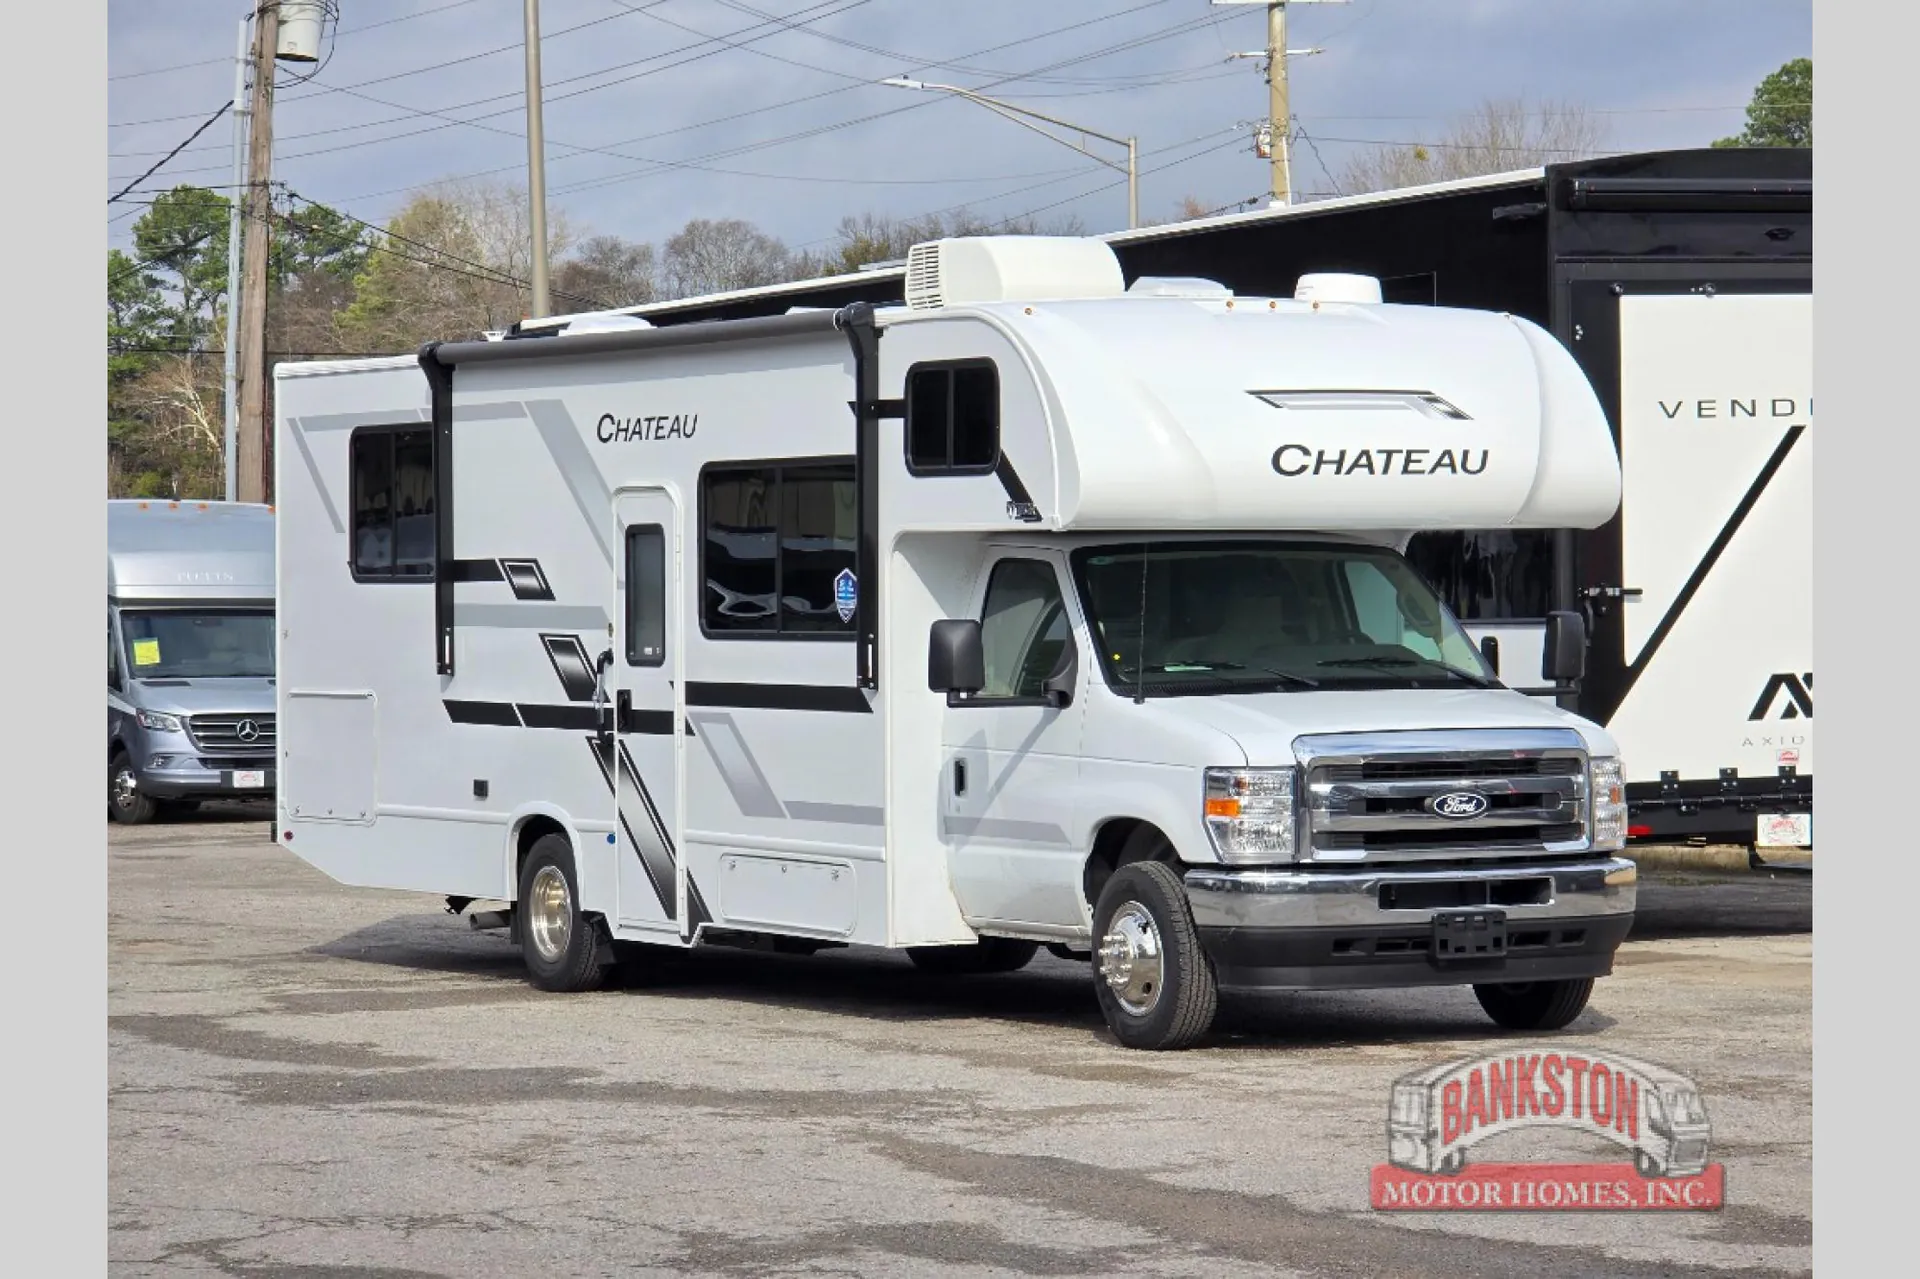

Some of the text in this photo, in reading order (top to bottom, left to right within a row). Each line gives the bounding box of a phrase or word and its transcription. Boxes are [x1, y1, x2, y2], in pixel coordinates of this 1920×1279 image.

[1658, 398, 1813, 419] VEND
[597, 412, 698, 443] CHATEAU
[1271, 443, 1489, 476] CHATEAU
[1444, 797, 1477, 812] Ford
